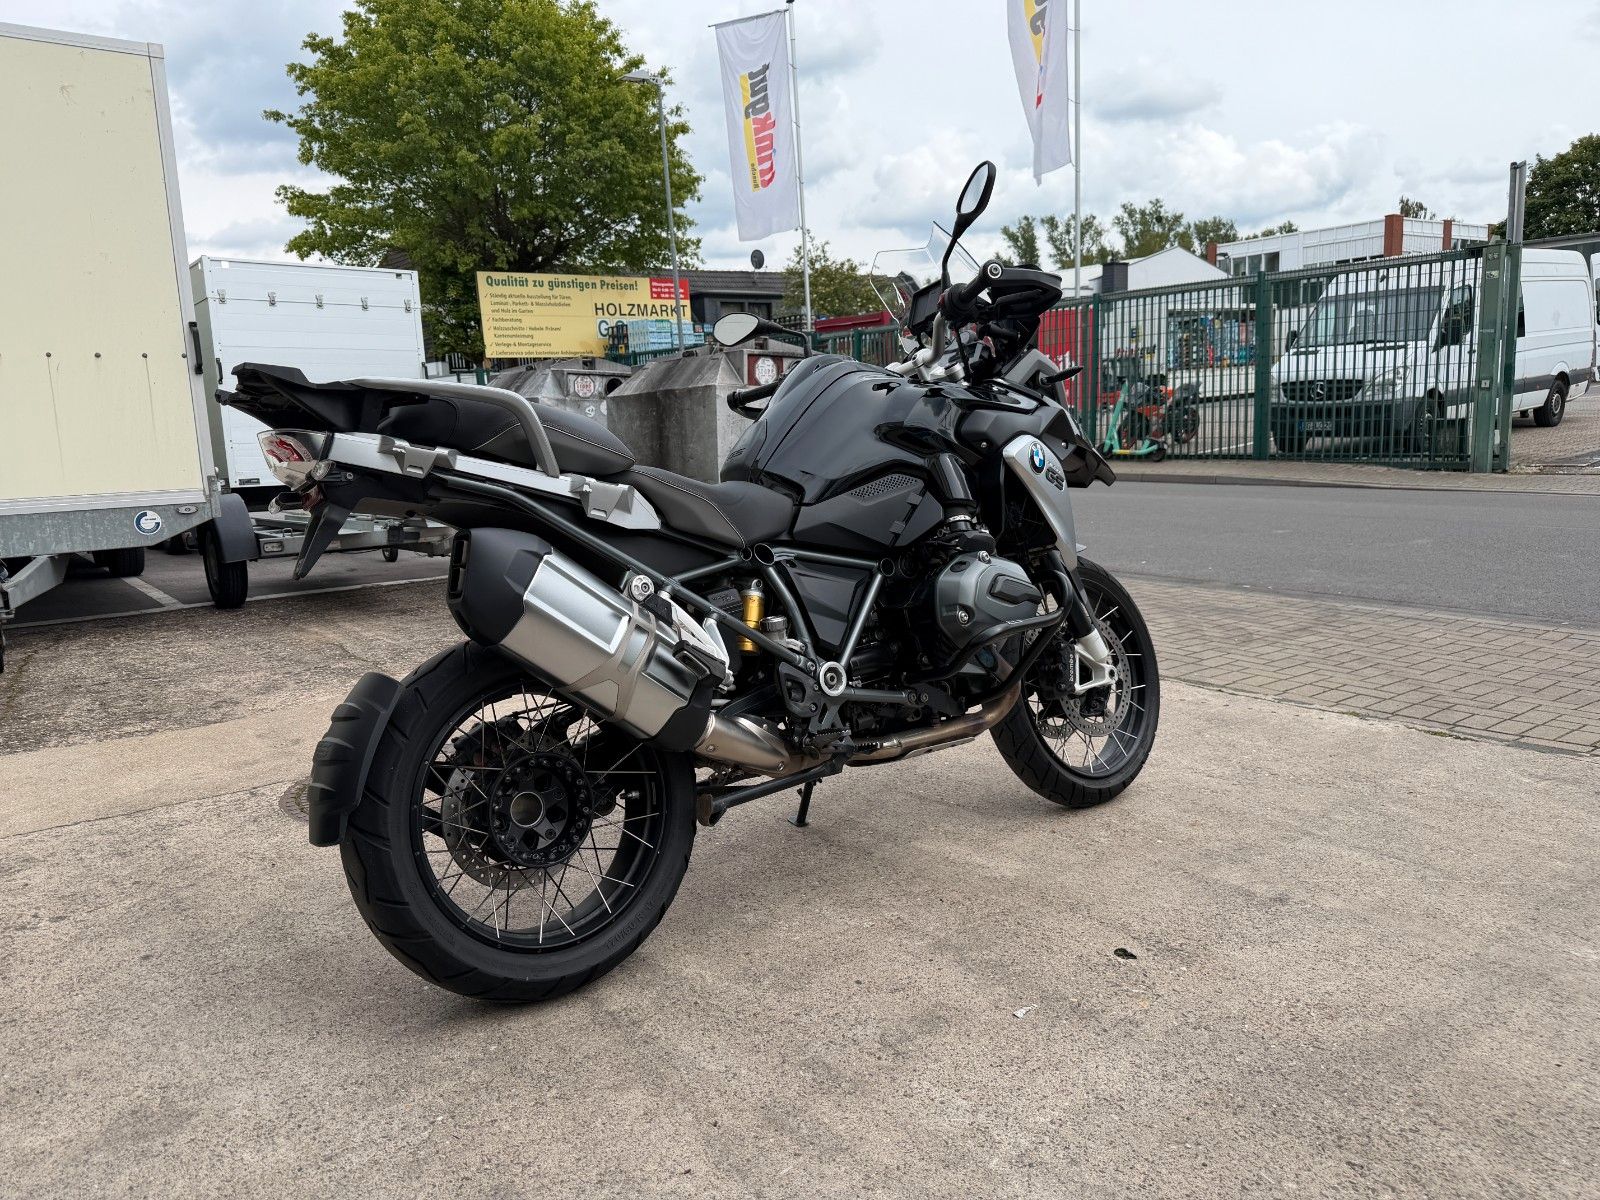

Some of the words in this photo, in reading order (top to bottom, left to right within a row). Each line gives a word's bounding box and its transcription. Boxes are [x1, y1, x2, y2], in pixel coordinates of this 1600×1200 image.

[486, 275, 529, 288] Qualität
[532, 279, 544, 288] zu
[548, 278, 597, 292] günstigen
[600, 279, 638, 291] Preisen!
